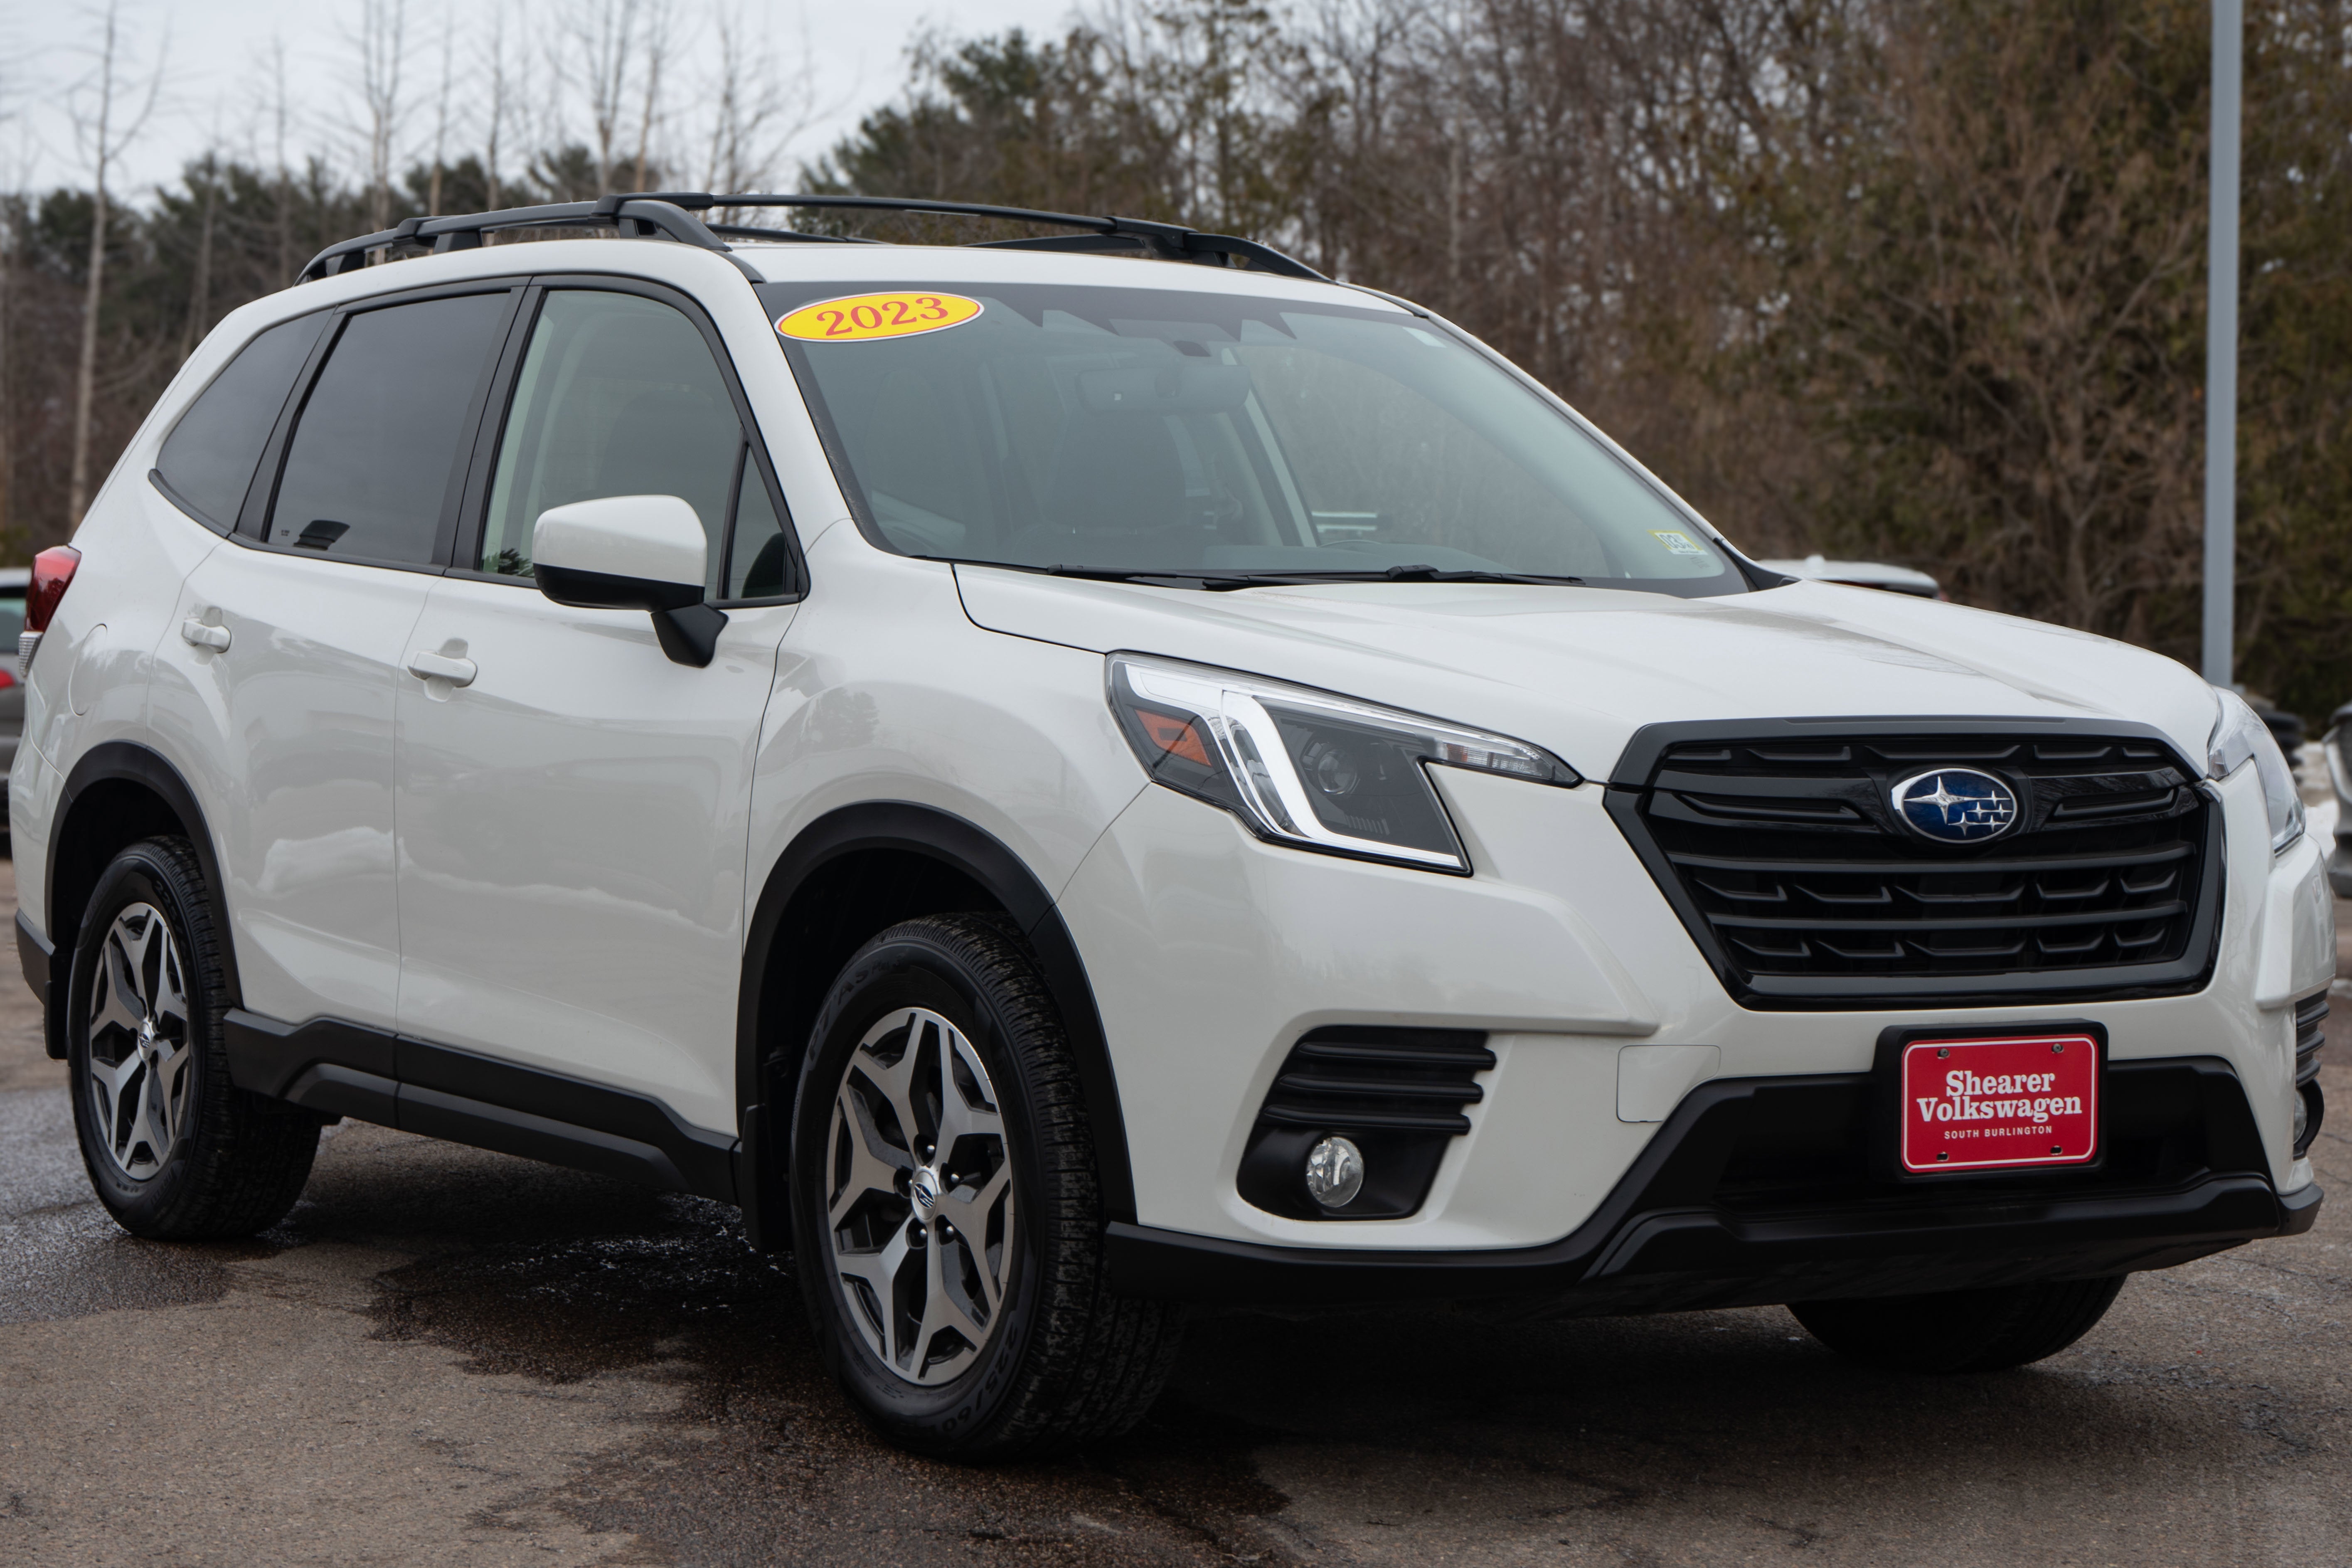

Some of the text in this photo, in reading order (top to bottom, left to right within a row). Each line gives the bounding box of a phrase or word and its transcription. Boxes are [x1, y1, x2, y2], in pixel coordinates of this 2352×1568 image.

[816, 297, 948, 336] 2023
[1946, 1070, 2055, 1097] Shearer
[1916, 1095, 2082, 1123] Volkswagen
[1944, 1125, 2052, 1140] SOUTH BURLINGTON
